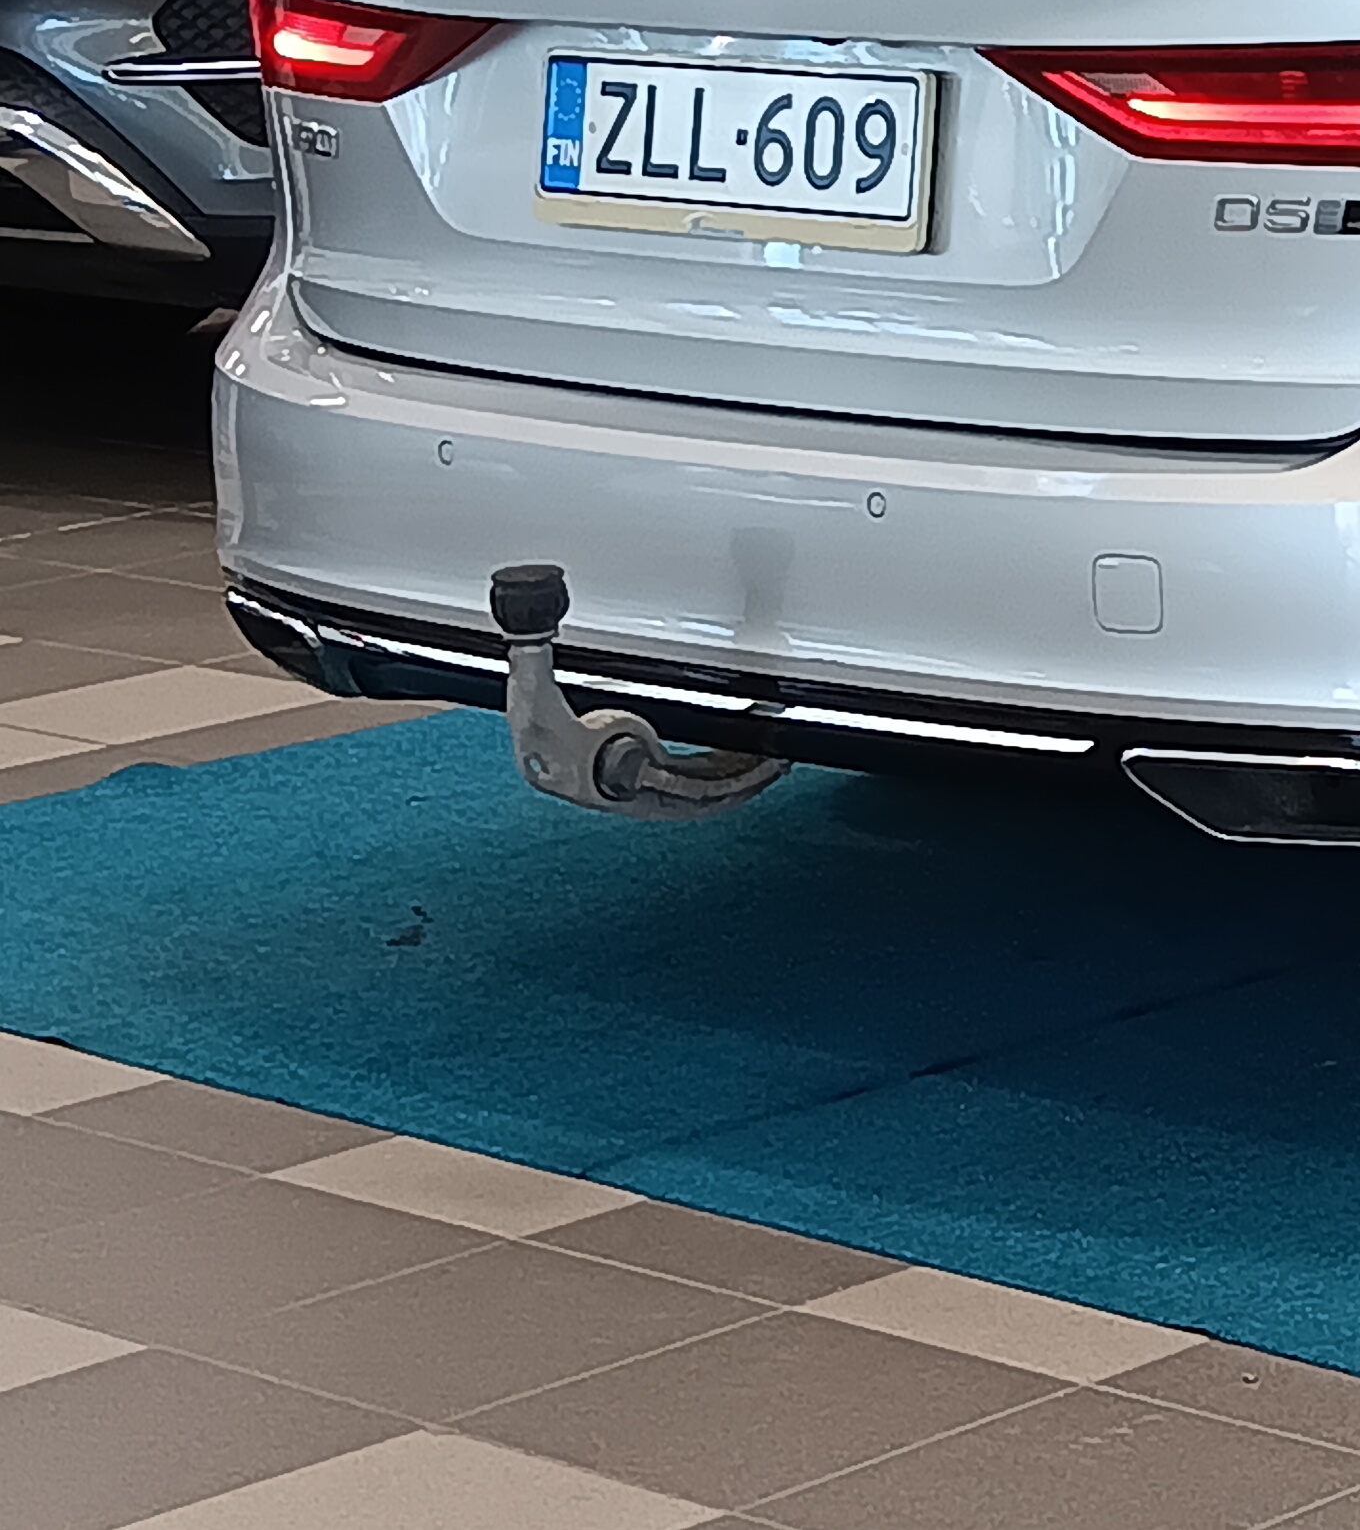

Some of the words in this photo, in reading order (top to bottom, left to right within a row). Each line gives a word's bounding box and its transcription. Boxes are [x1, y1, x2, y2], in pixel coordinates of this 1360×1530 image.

[546, 137, 580, 167] FIN
[595, 81, 897, 194] ZLL-609
[1214, 196, 1312, 234] D5
